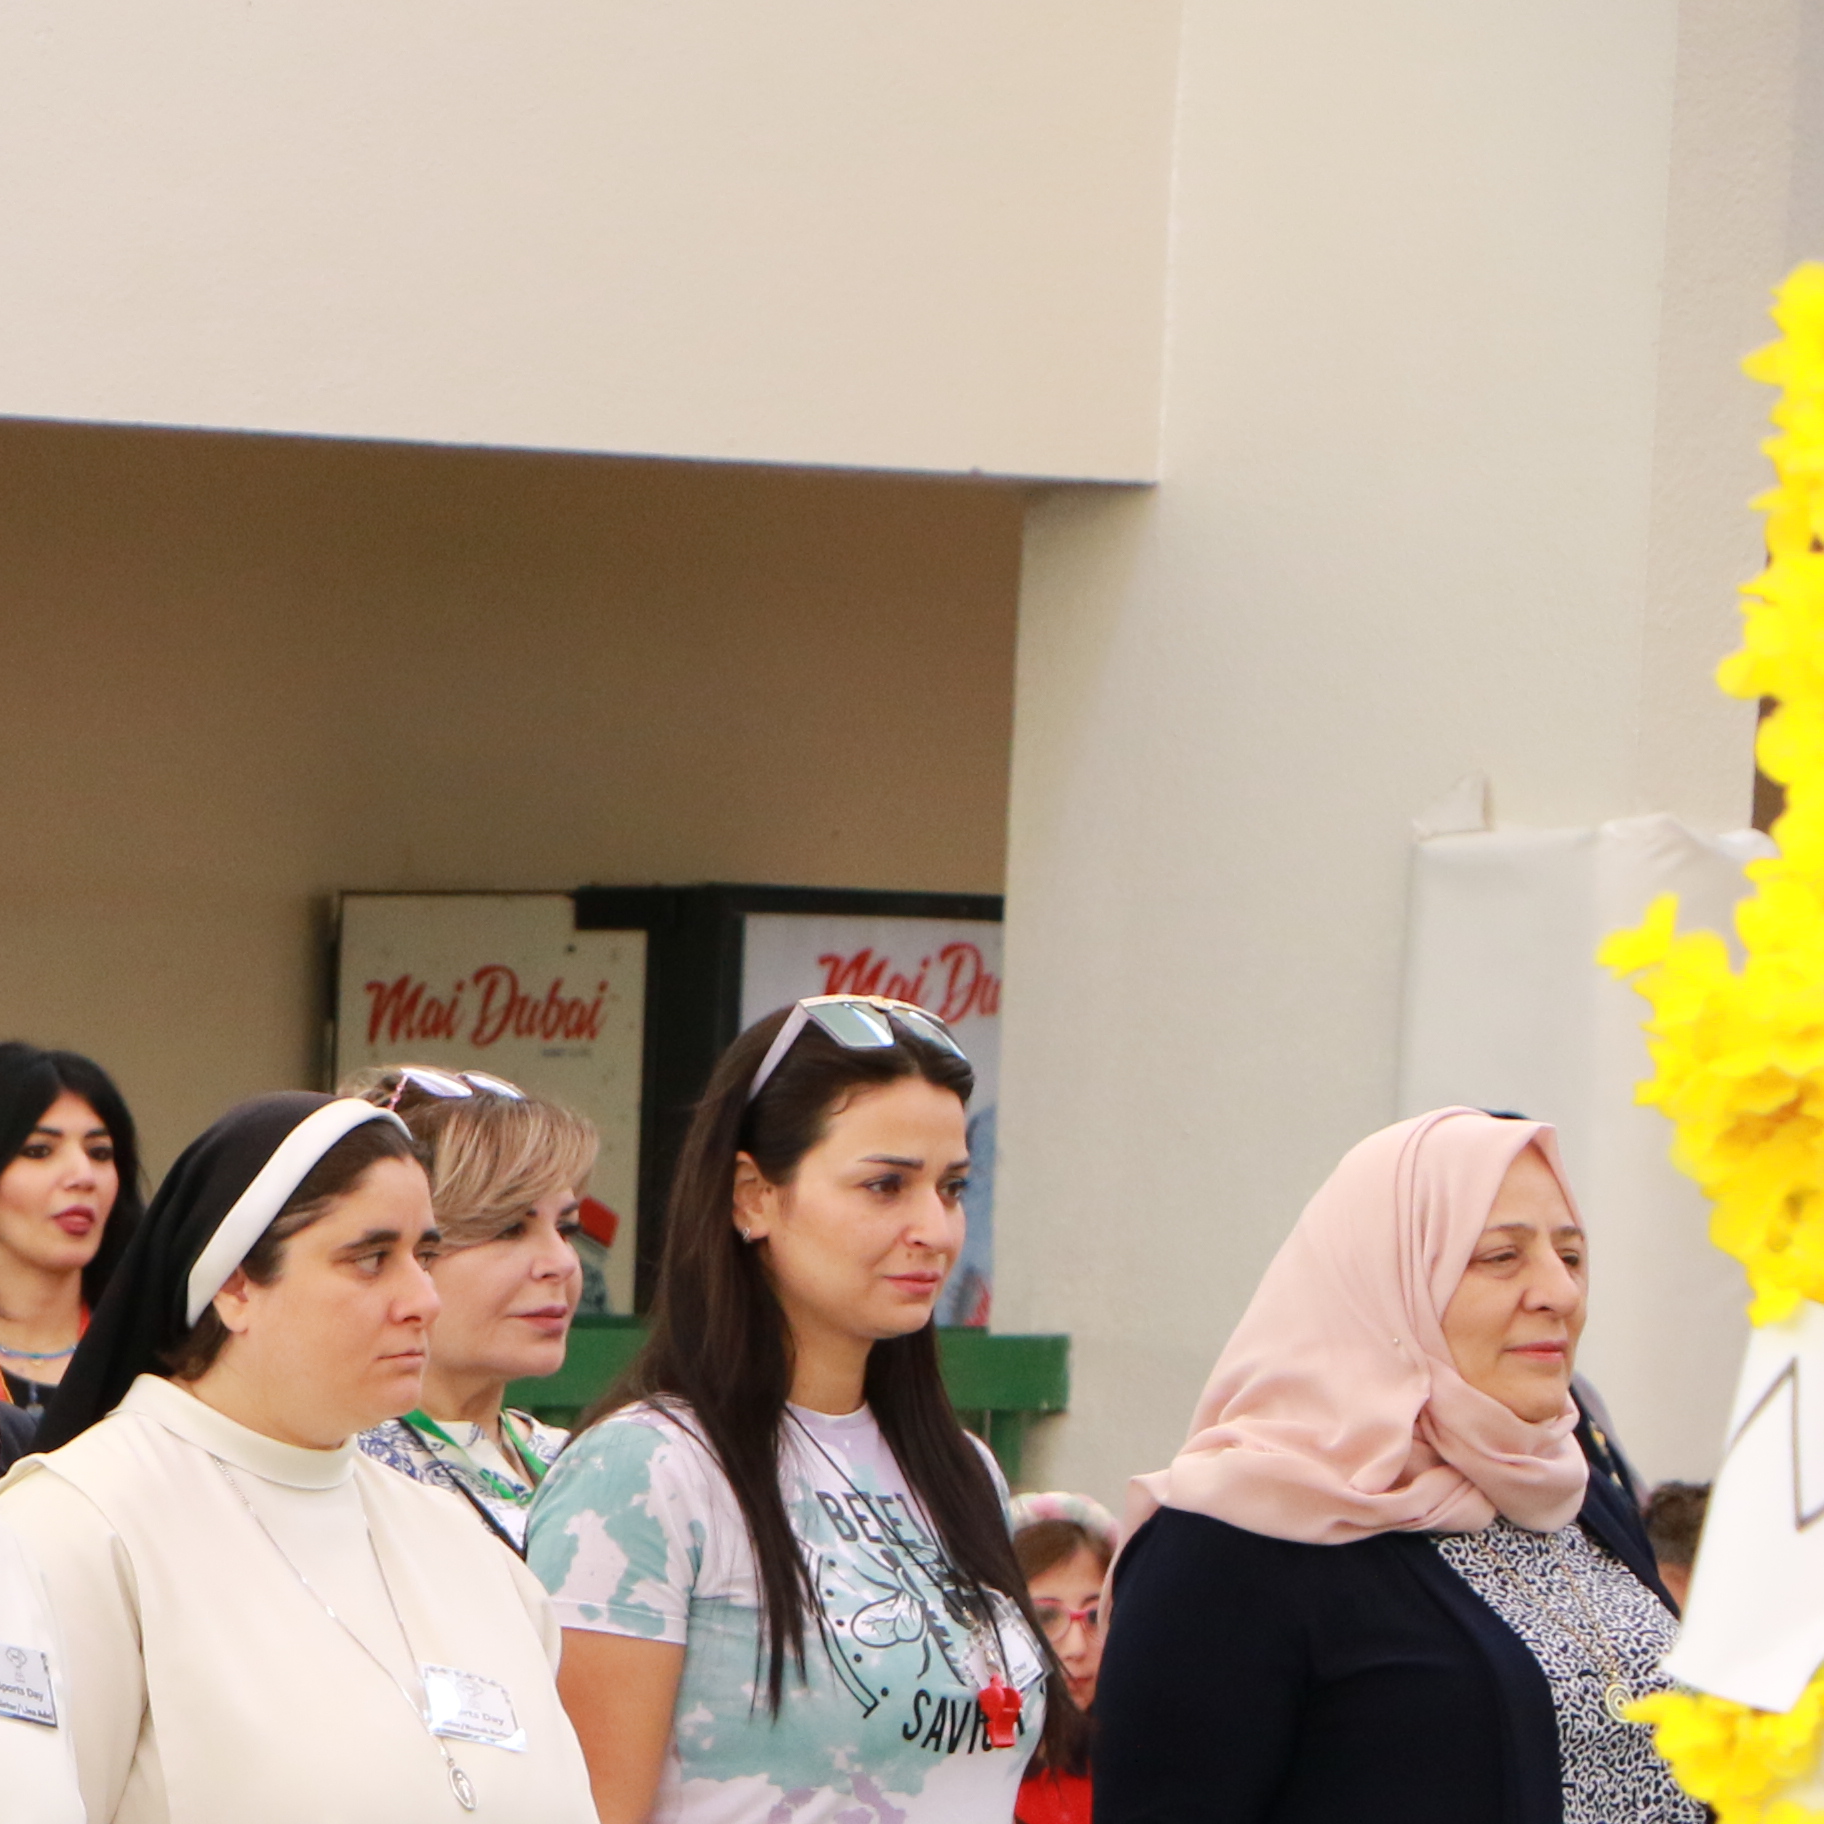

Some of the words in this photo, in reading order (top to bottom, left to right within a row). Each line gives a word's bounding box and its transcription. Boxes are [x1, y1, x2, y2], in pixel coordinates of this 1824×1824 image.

[364, 973, 465, 1046] Mai
[469, 963, 609, 1050] Dubai
[26, 1688, 44, 1702] Day
